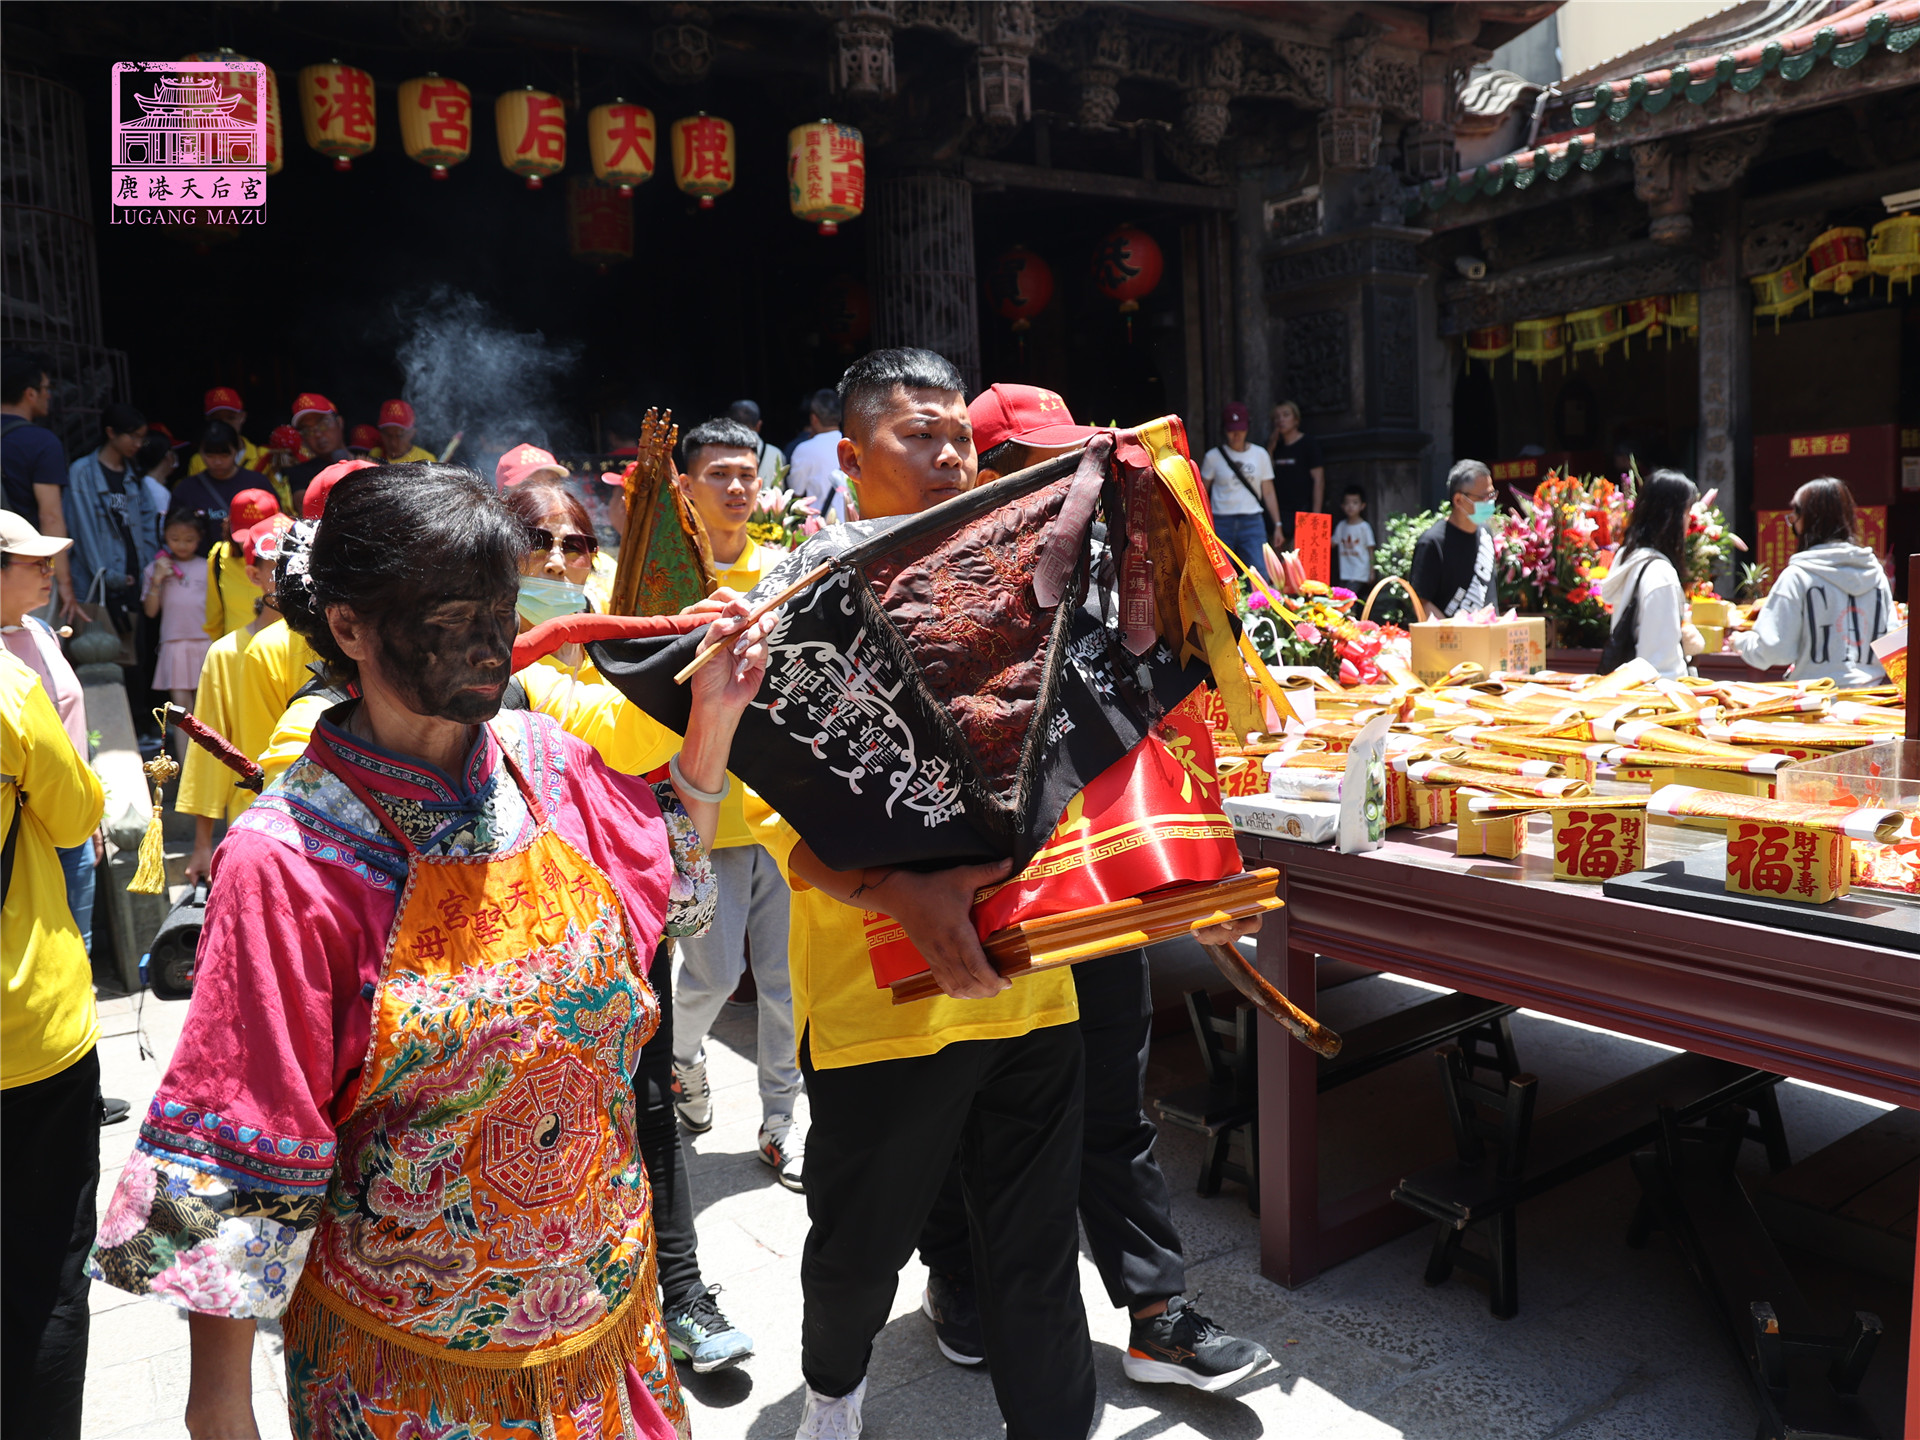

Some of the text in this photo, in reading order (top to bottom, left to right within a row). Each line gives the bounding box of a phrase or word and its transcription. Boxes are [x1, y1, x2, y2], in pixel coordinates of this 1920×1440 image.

[315, 66, 375, 142] 港
[418, 80, 472, 151] 宮
[515, 95, 566, 163] 后
[604, 104, 653, 171] 天
[680, 116, 732, 182] 鹿
[805, 131, 822, 200] 國泰民安
[1790, 434, 1849, 457] 點香台
[1245, 815, 1273, 831] krunch
[1252, 811, 1266, 822] oat
[1557, 811, 1619, 879] 福
[1727, 823, 1793, 895] 福
[1792, 831, 1820, 898] 財子壽
